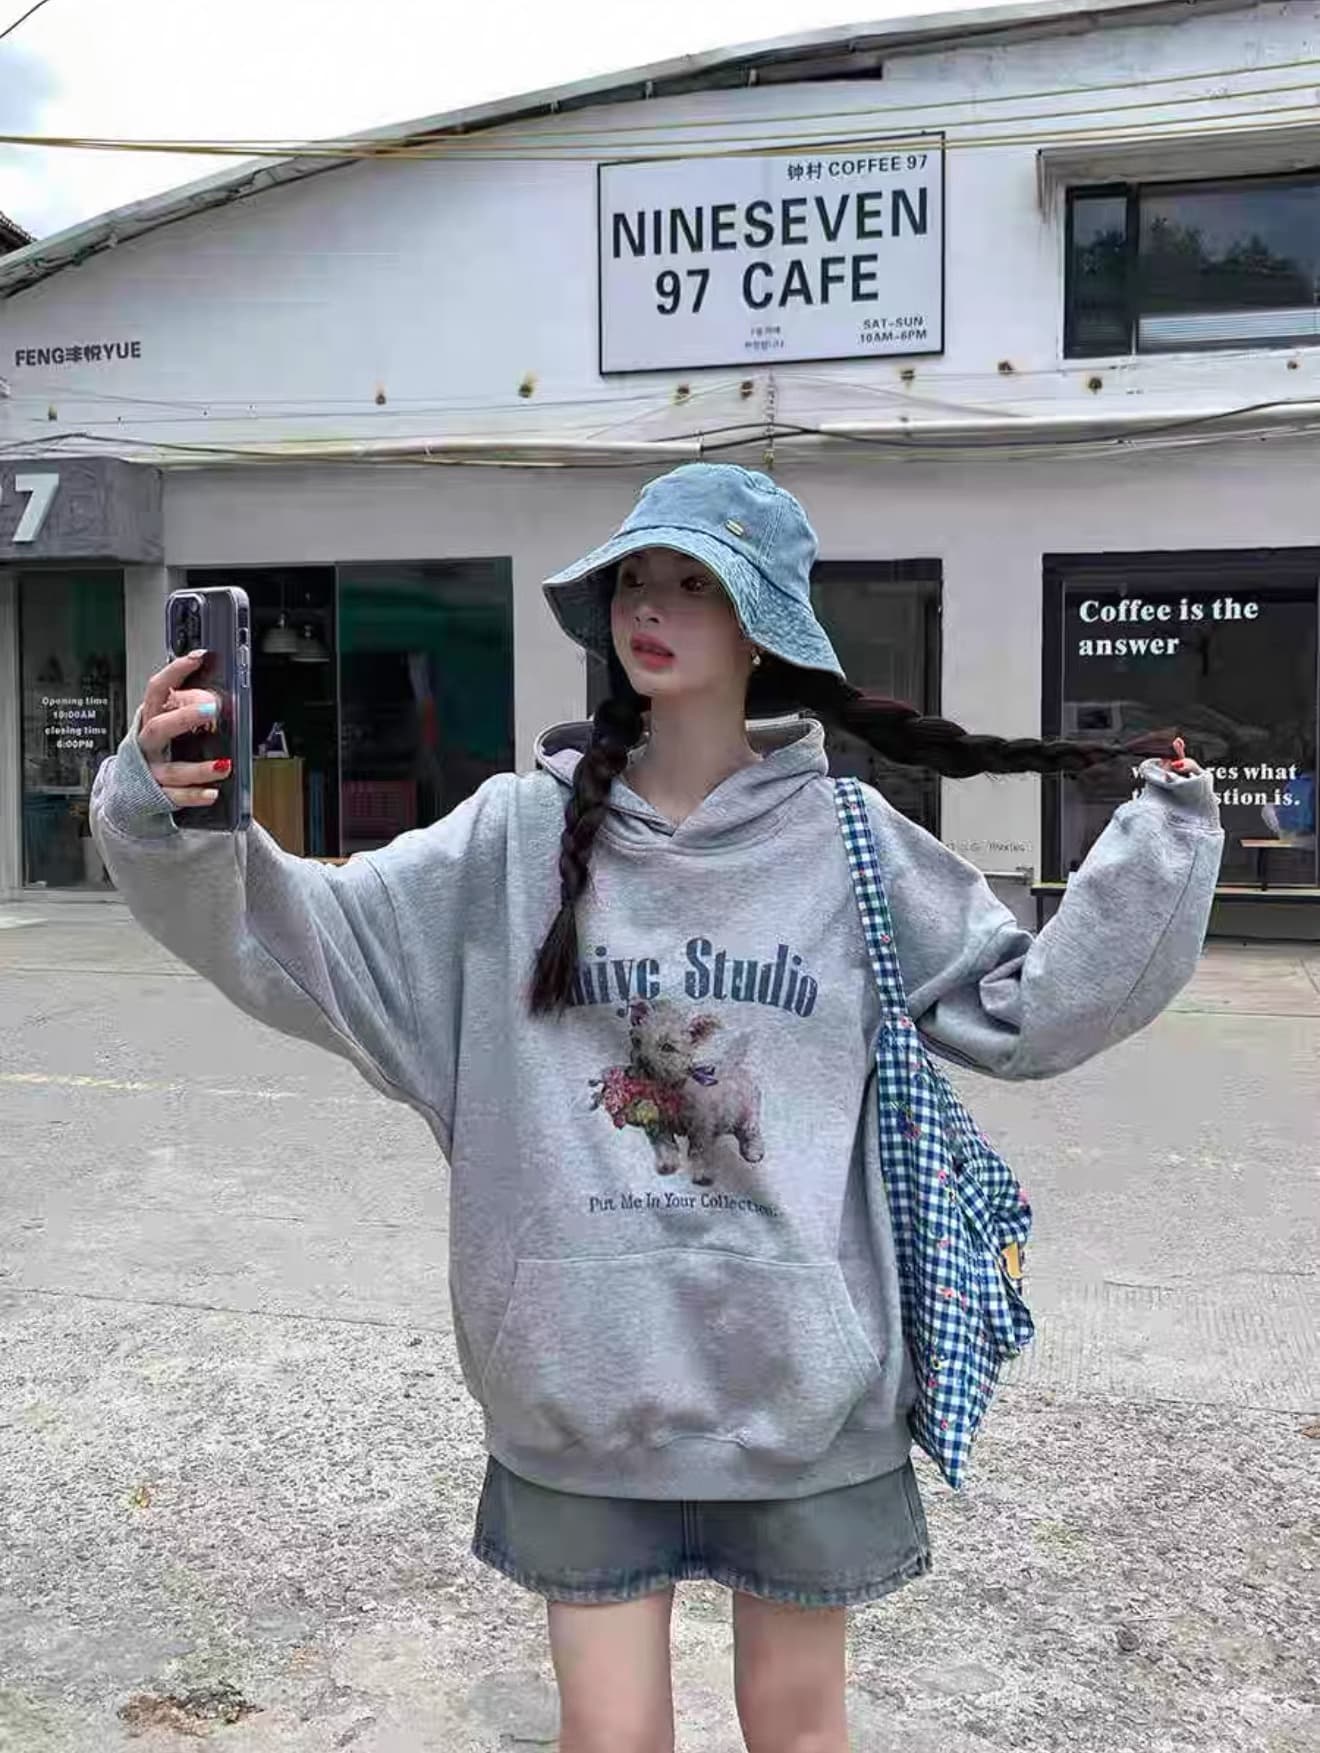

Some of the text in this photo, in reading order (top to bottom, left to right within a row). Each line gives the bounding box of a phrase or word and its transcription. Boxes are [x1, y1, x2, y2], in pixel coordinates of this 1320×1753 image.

[828, 155, 901, 177] COFFEE
[906, 154, 928, 170] 97
[612, 187, 928, 258] NINESEVEN
[655, 254, 879, 315] 97 CAFE
[863, 316, 924, 330] SAT-SUN
[859, 328, 927, 344] 10AM-6PM
[1079, 597, 1259, 623] Coffee is the
[1078, 637, 1180, 656] answer
[1244, 763, 1298, 780] what
[1273, 789, 1301, 806] is.
[684, 937, 818, 1018] Studio
[590, 1196, 616, 1213] Put
[621, 1193, 643, 1209] Me
[645, 1192, 661, 1209] In
[664, 1192, 697, 1209] Your
